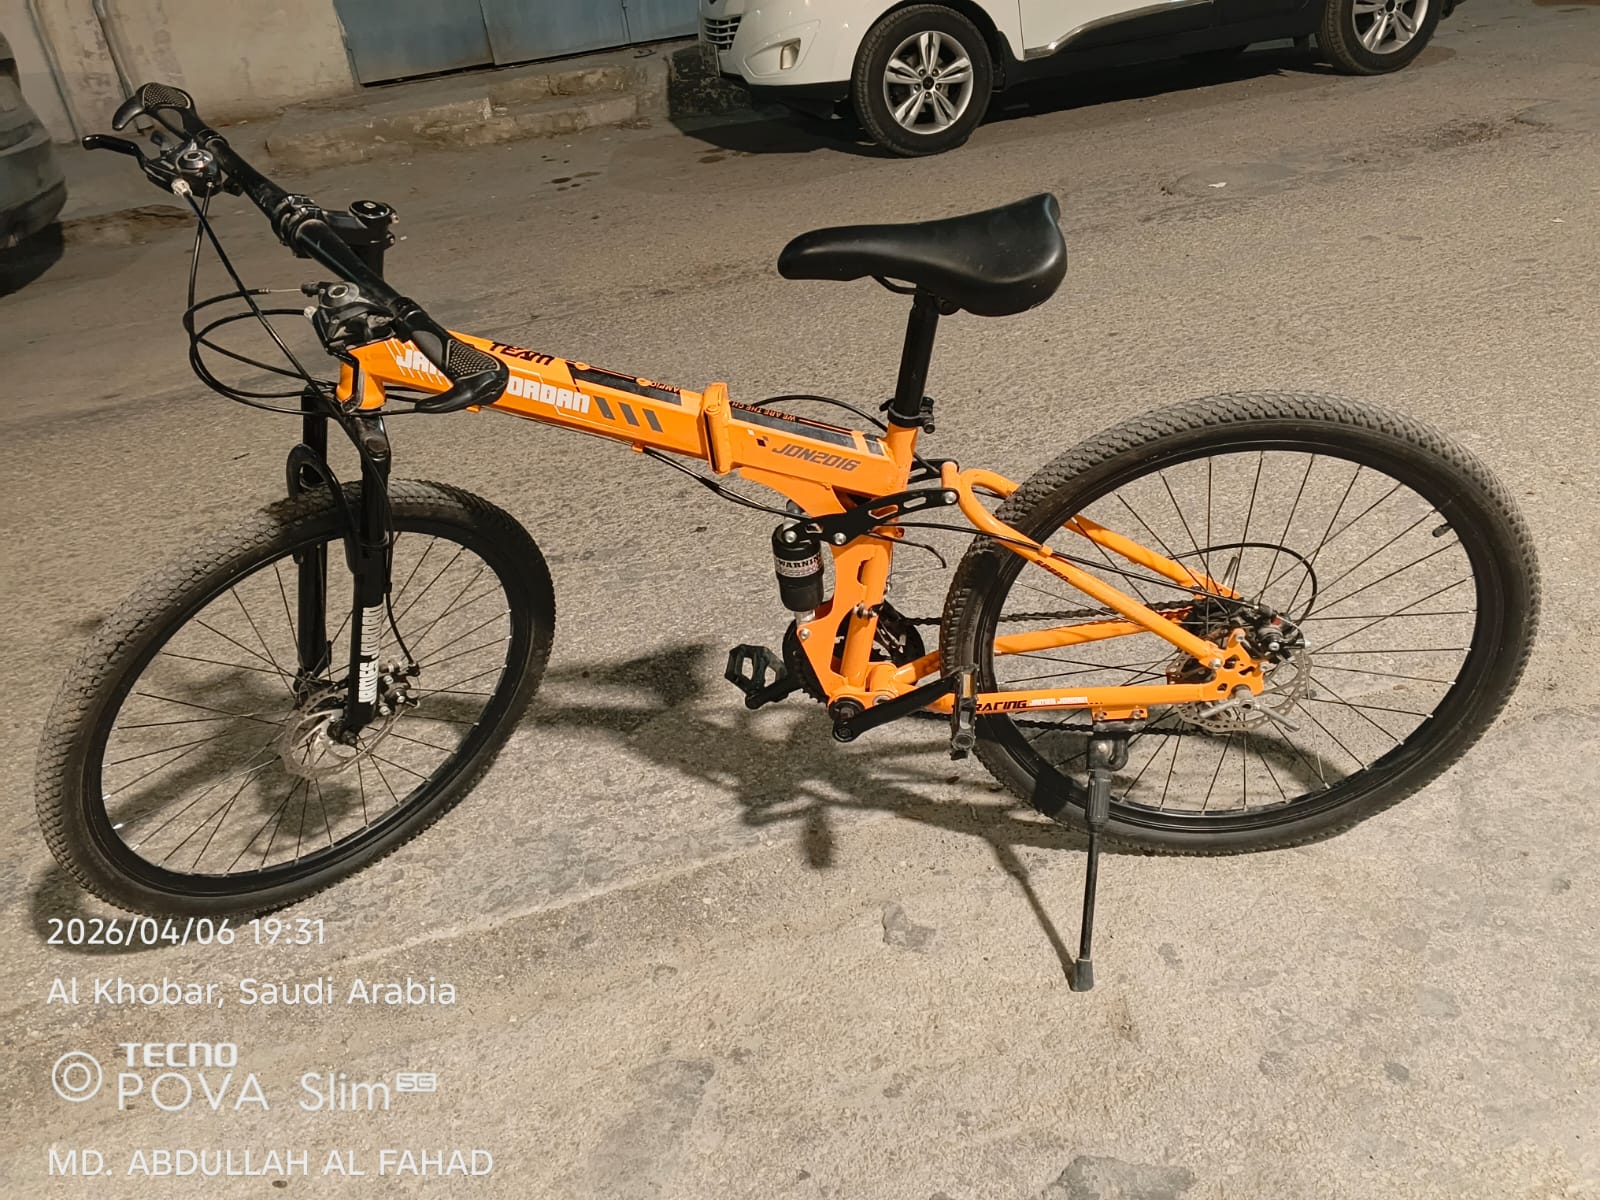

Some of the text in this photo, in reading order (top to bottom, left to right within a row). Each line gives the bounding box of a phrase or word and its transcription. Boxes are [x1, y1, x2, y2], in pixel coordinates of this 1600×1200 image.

[490, 341, 556, 367] TEAM
[506, 374, 590, 415] ORDAN
[745, 403, 762, 414] THE
[763, 409, 782, 418] ARE
[772, 443, 861, 472] JDN2016
[358, 605, 383, 704] JAMES JORDAN
[975, 699, 1028, 712] RACING
